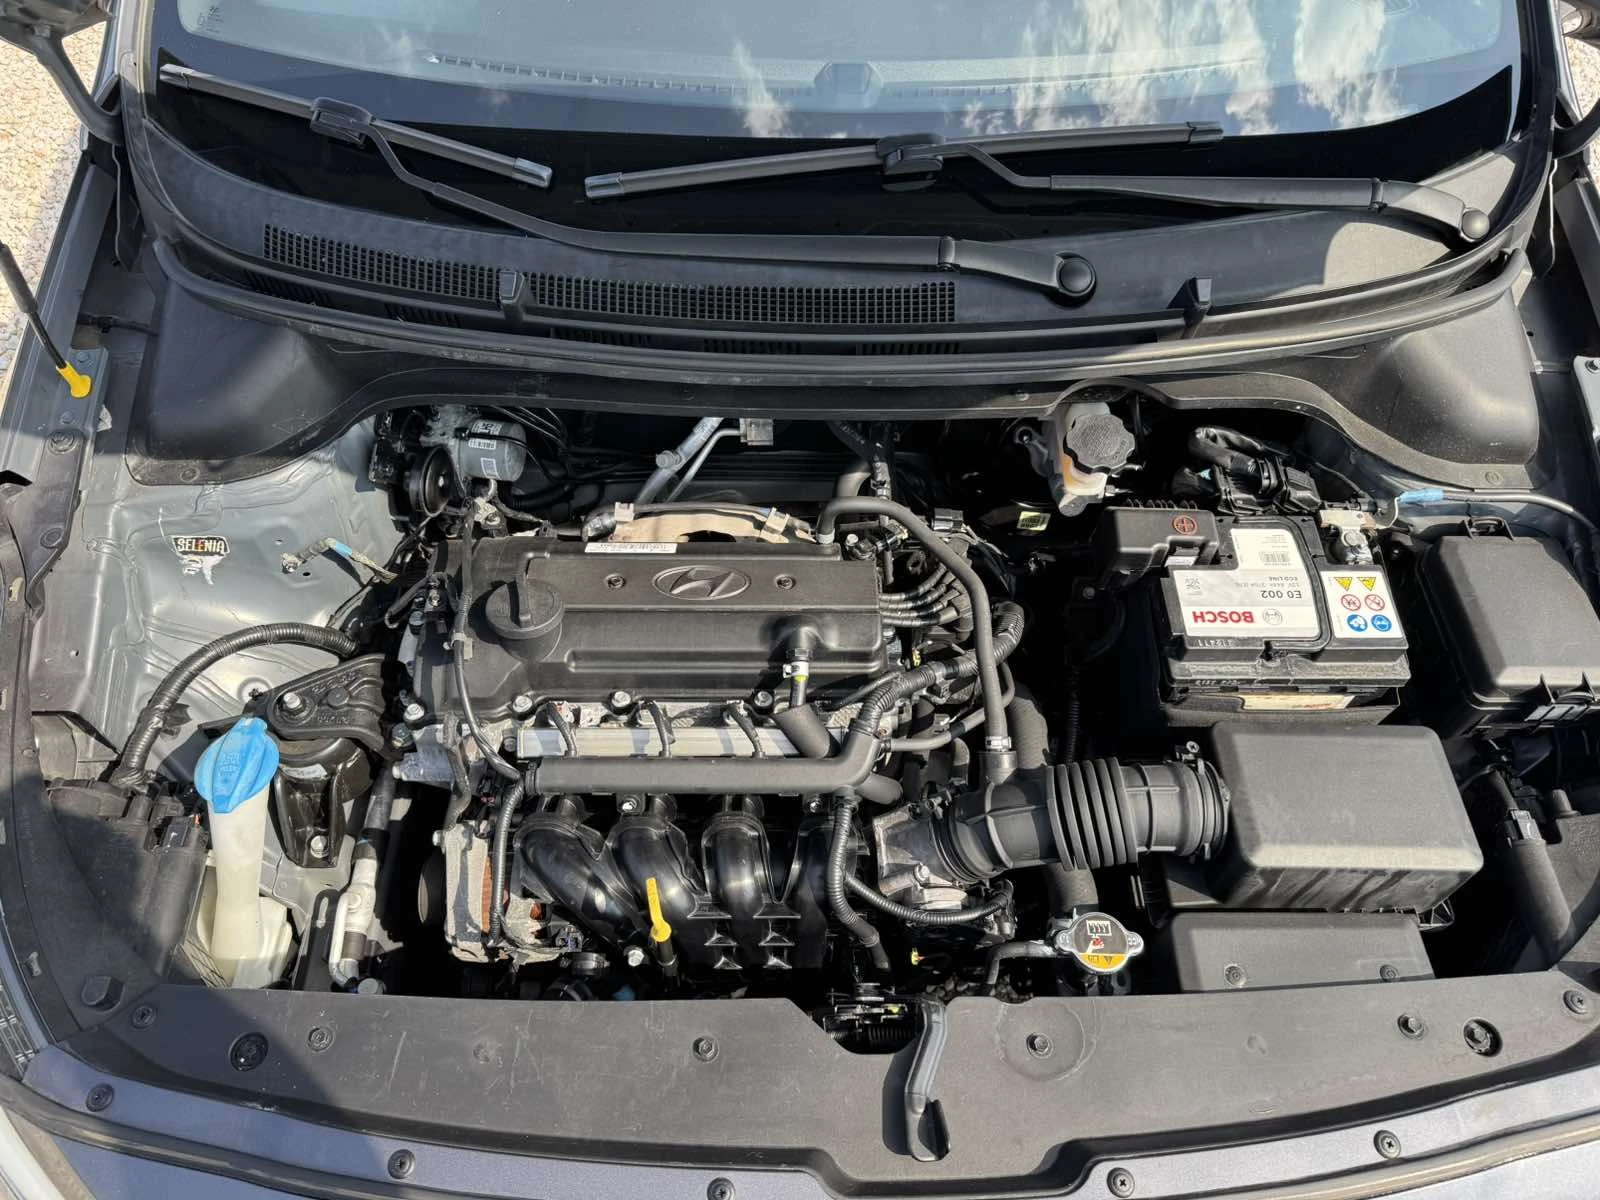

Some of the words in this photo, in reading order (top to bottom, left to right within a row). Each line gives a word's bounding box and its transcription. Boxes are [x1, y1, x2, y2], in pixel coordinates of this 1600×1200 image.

[177, 538, 226, 555] SELENIA
[1260, 590, 1283, 599] 002
[1192, 611, 1255, 623] BOSCH
